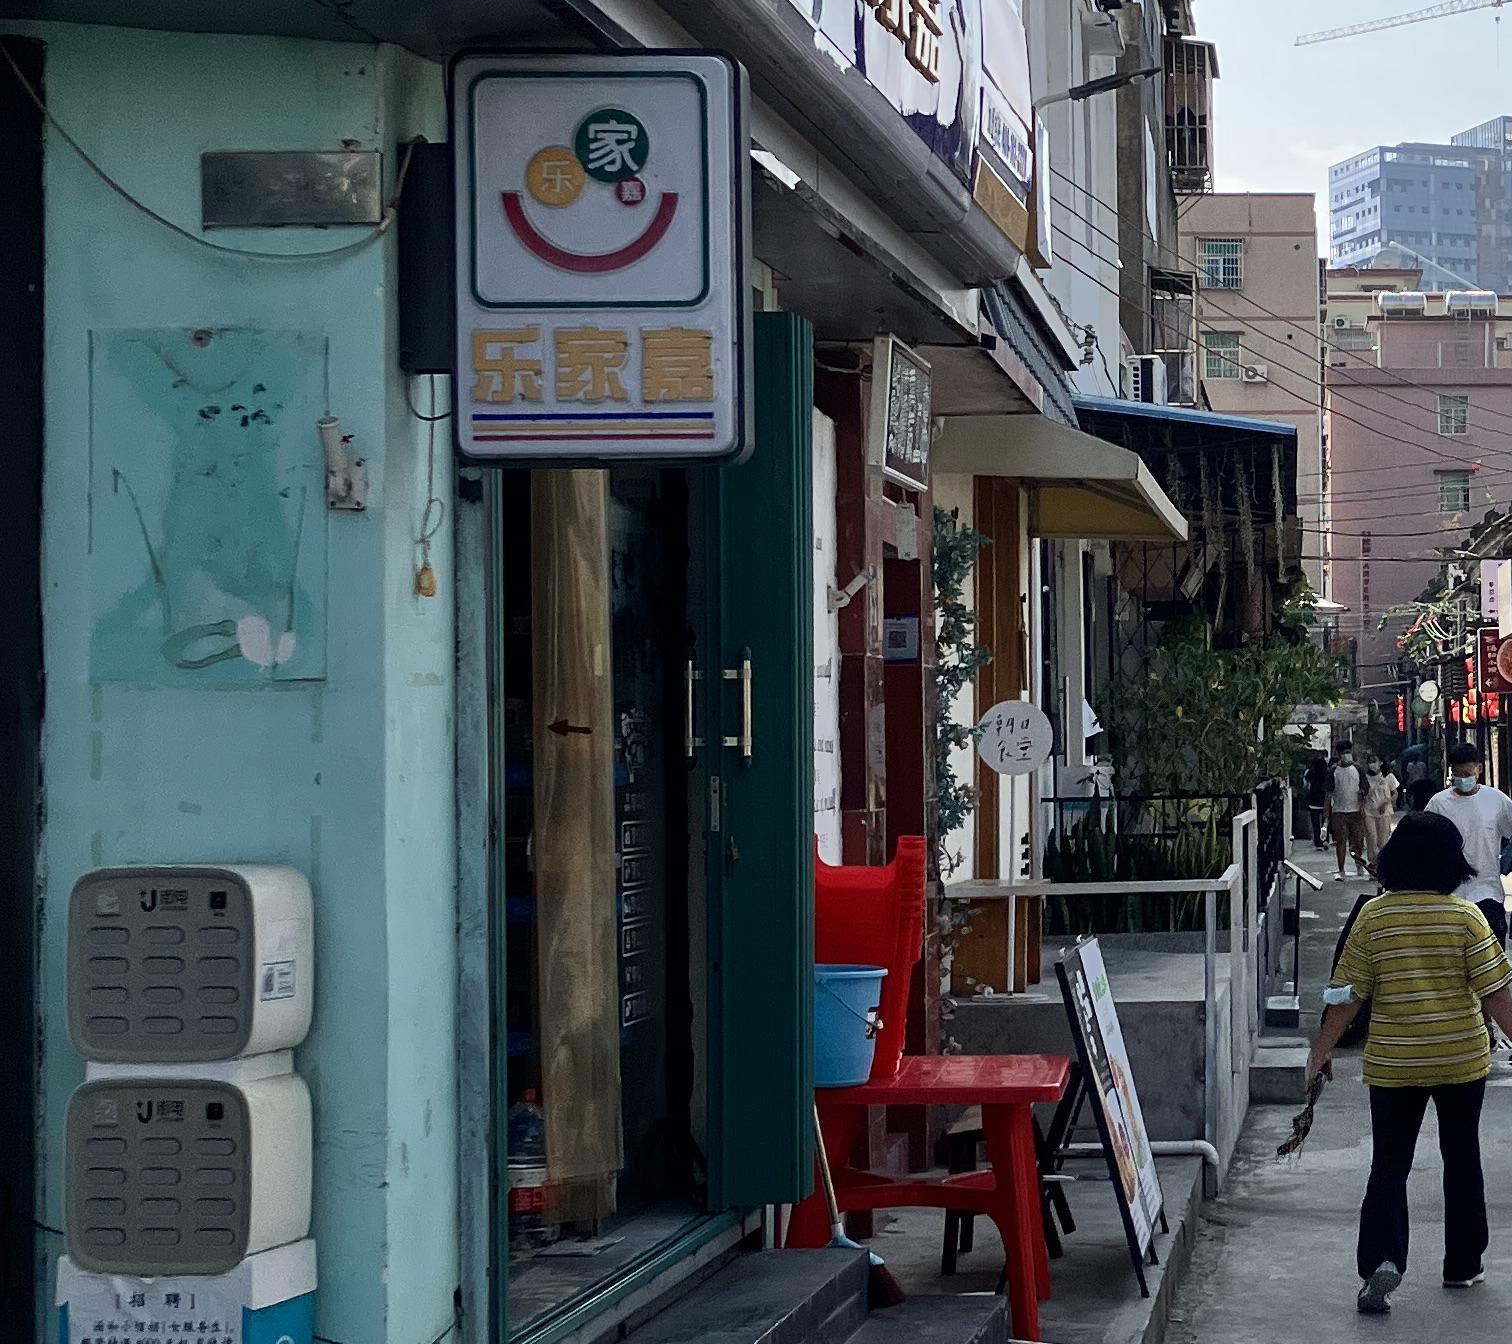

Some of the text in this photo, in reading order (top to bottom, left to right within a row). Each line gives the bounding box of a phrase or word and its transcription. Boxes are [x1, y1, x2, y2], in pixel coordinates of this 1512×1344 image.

[587, 119, 640, 173] 家
[540, 159, 575, 193] 乐
[471, 326, 715, 404] 乐家嘉
